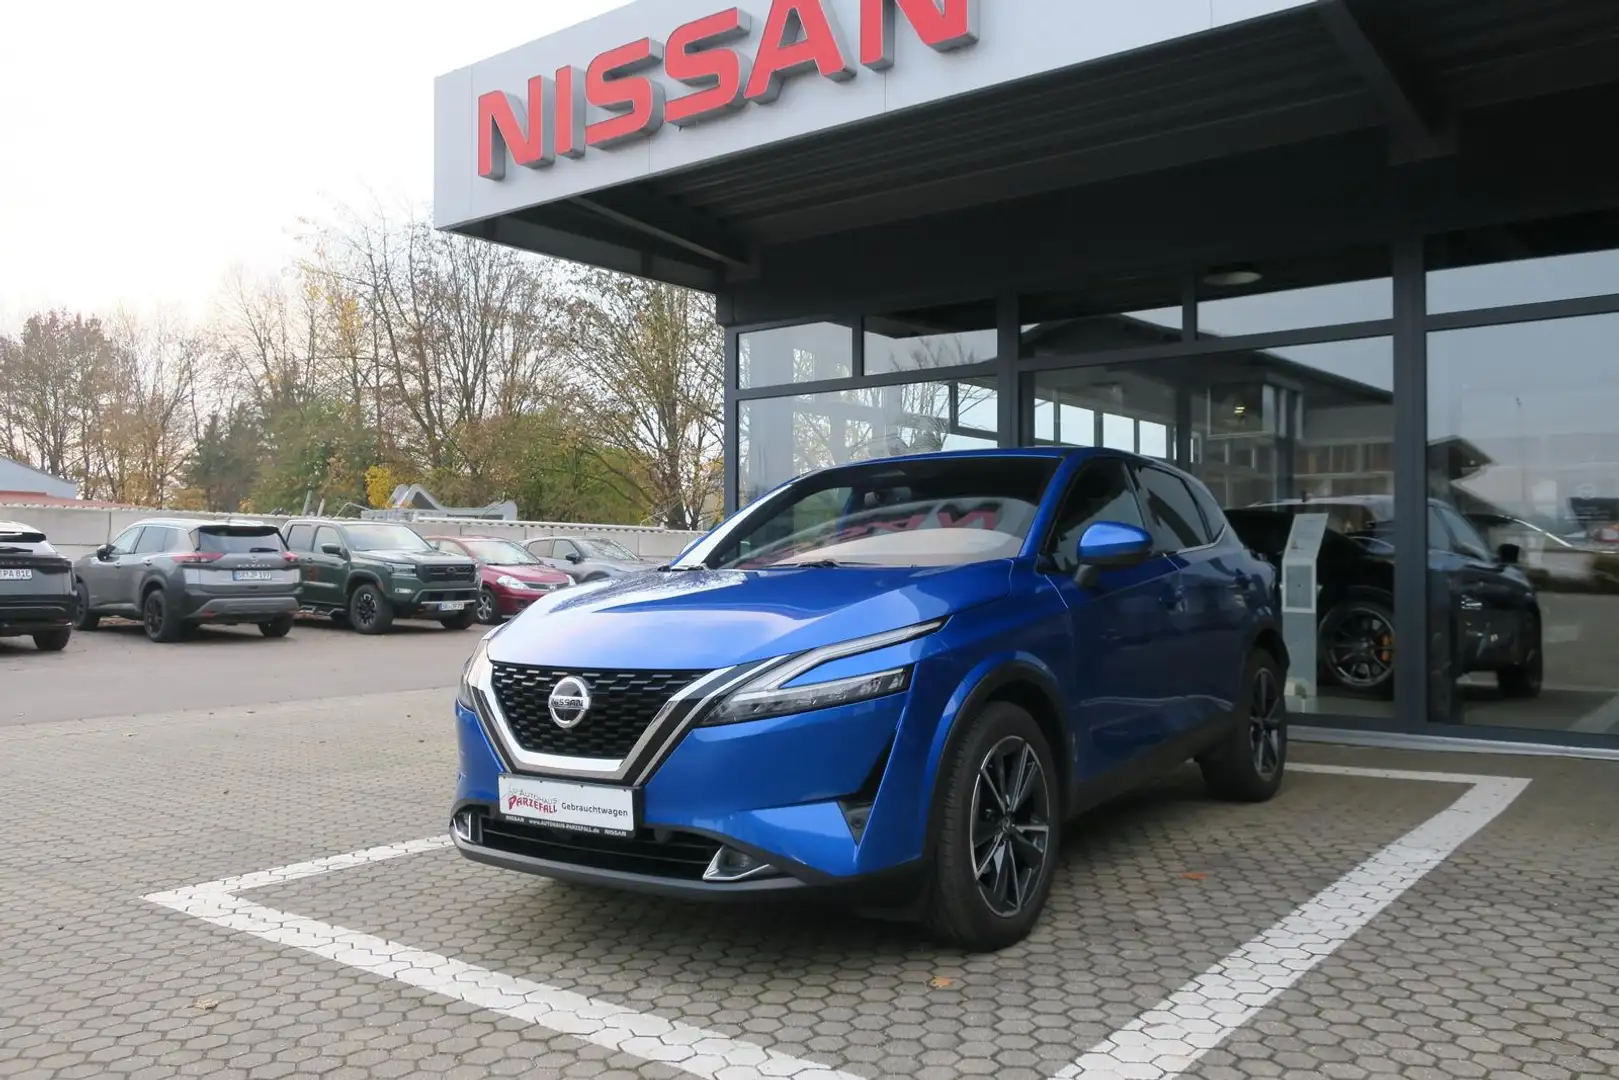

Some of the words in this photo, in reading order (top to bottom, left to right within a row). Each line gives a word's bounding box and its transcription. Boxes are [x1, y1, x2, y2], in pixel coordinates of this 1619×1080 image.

[551, 698, 584, 707] NISSAN
[508, 795, 558, 814] PARZEFALL
[519, 788, 558, 805] AUTOHAUS
[561, 802, 629, 817] Gebrauchtwagen
